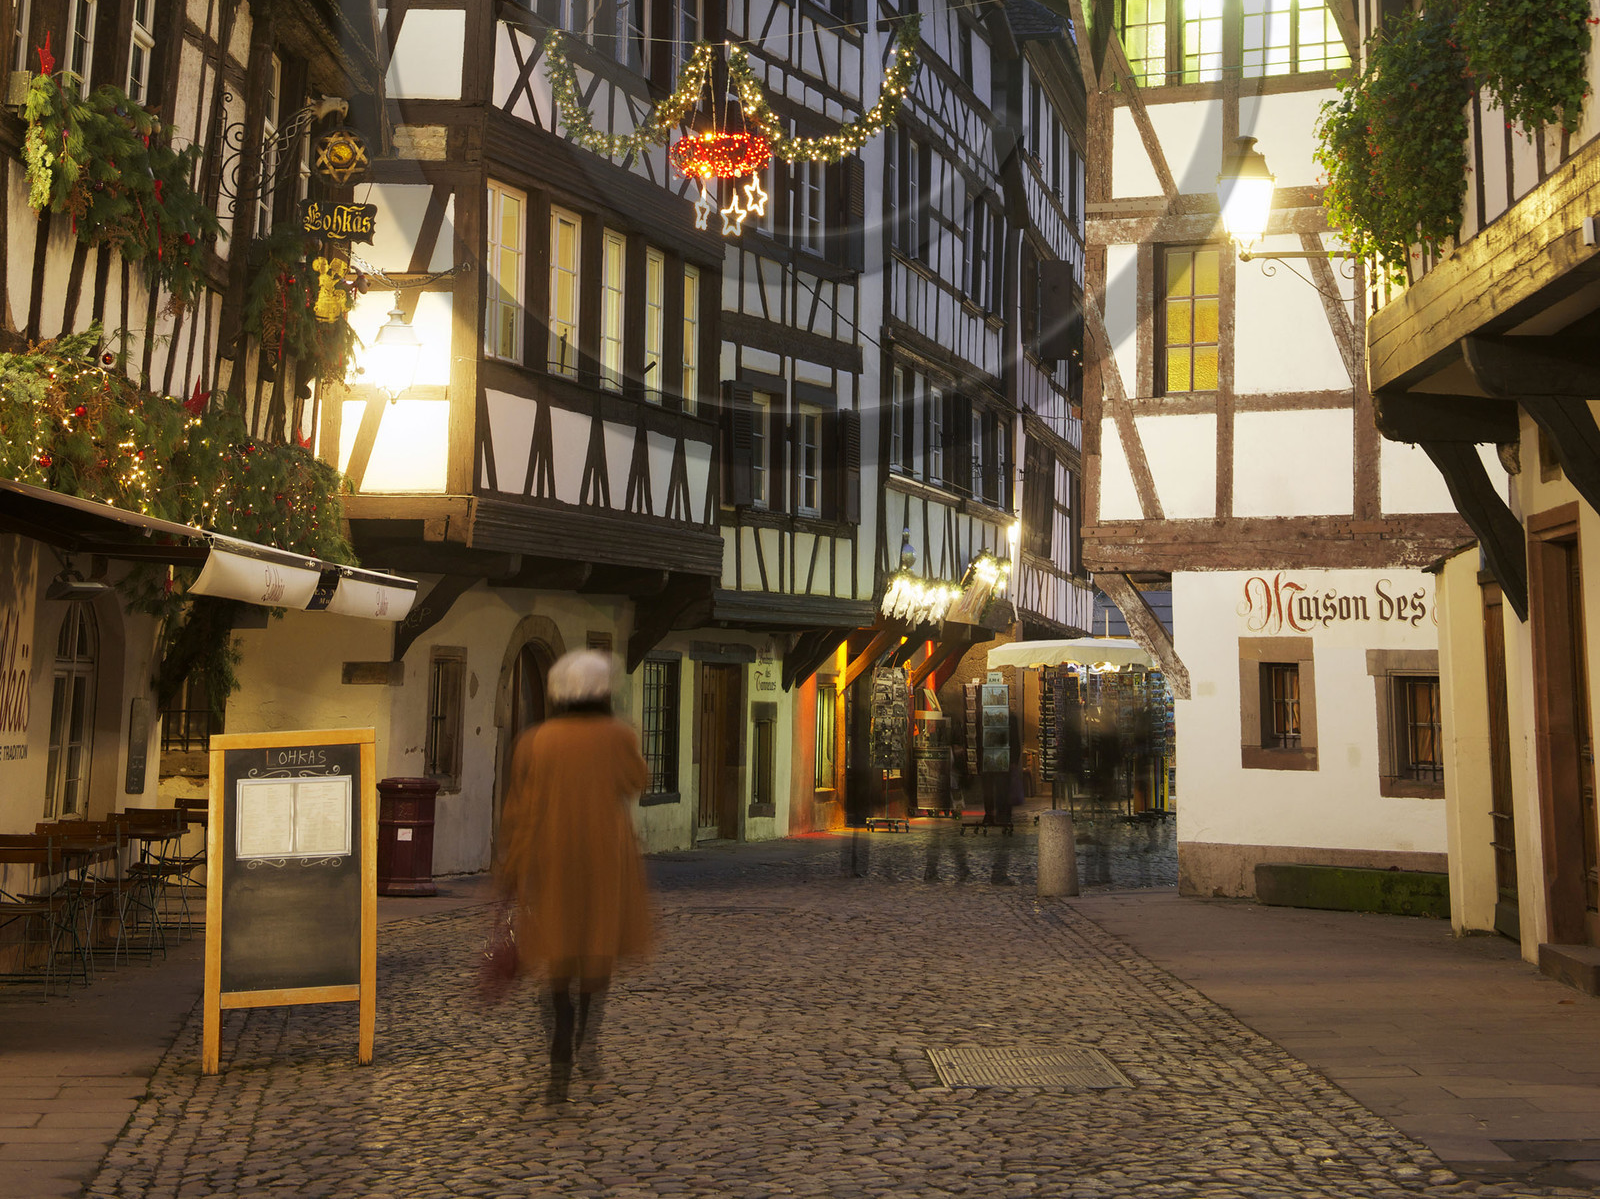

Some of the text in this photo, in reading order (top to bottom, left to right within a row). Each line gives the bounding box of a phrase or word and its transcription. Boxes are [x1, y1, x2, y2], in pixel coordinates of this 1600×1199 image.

[303, 203, 371, 239] Lohkäs
[1237, 571, 1370, 634] Maison
[1375, 578, 1426, 628] des
[3, 744, 29, 761] TRADITION
[266, 750, 327, 767] LOHKAS
